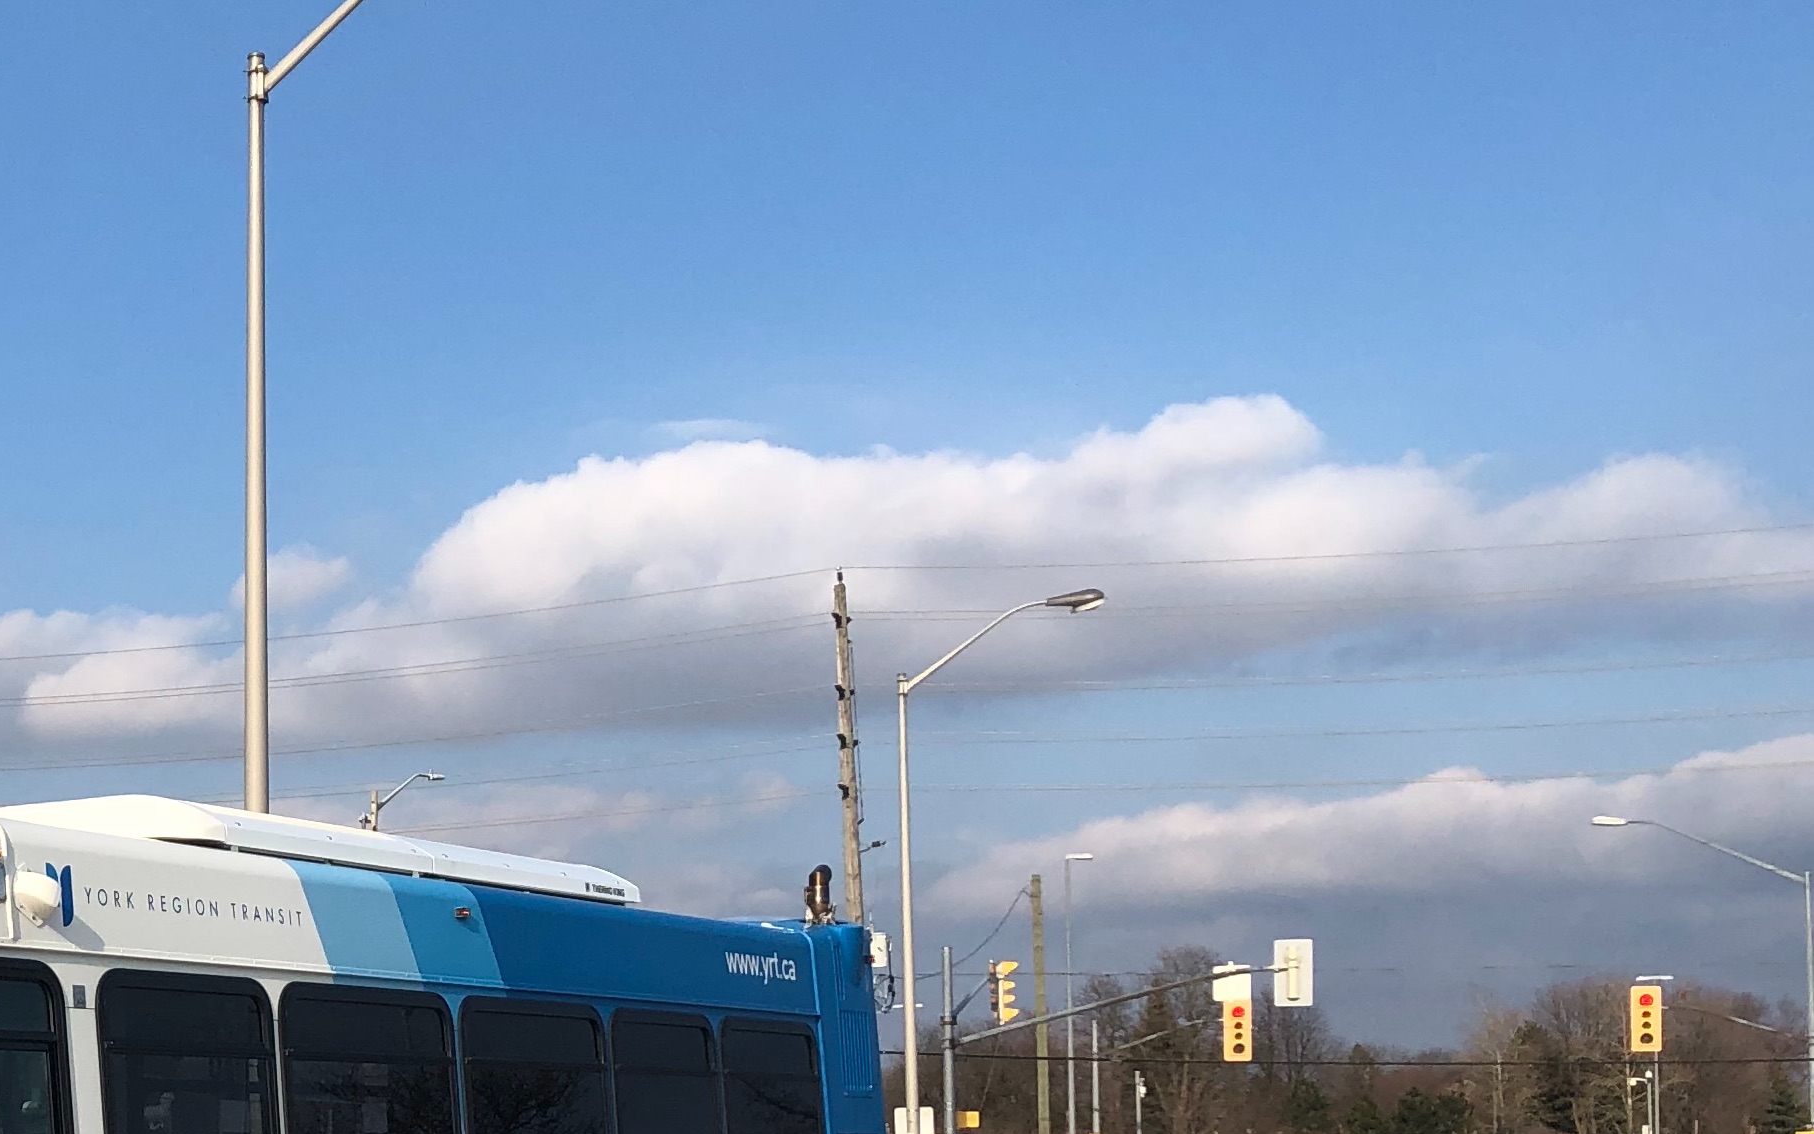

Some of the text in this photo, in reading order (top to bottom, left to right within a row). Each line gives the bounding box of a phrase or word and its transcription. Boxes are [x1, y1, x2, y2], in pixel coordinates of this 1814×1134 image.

[83, 886, 303, 927] YORK REGION TRANSIT
[725, 952, 797, 985] www.yrt.ca
